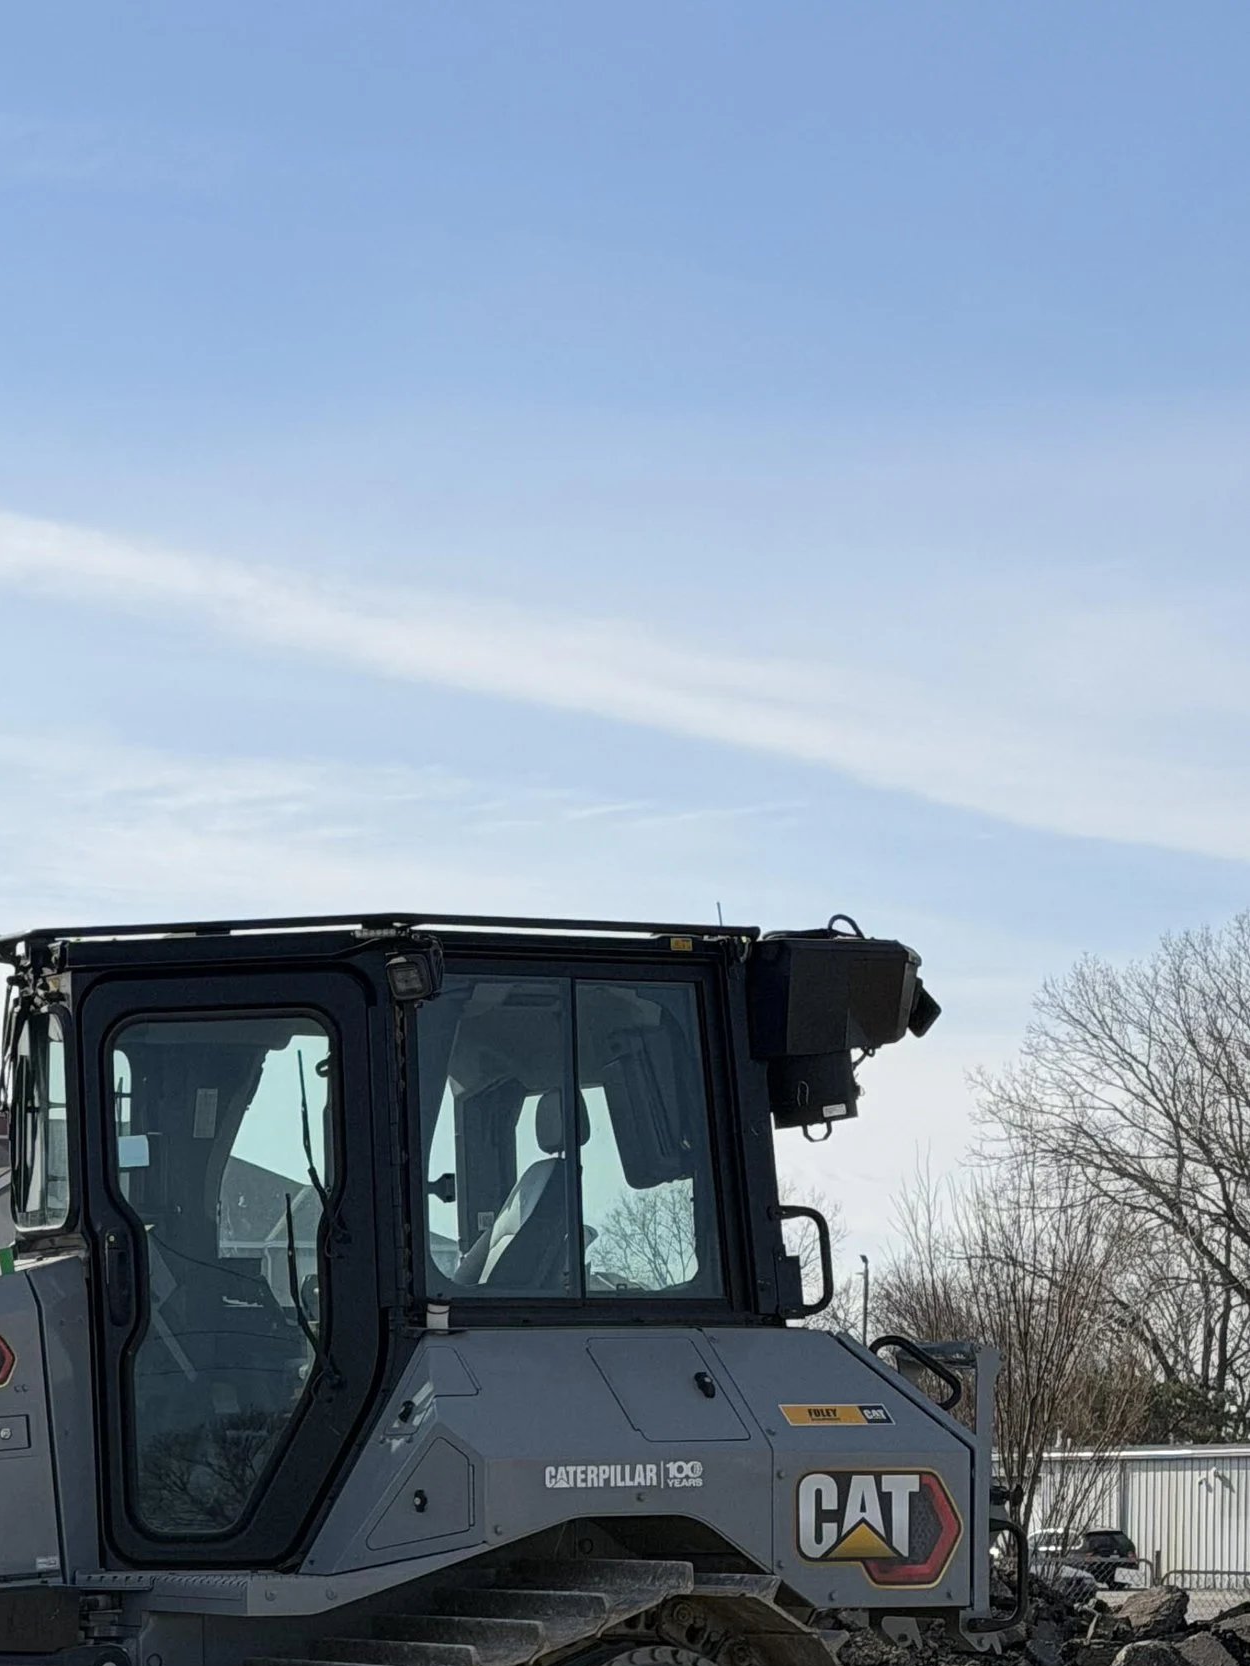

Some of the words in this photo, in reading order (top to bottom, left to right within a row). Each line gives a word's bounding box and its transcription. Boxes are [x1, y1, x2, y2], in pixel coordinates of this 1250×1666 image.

[863, 1409, 886, 1419] CAT
[545, 1464, 657, 1488] CATERPILLAR
[666, 1461, 703, 1478] 100
[666, 1478, 703, 1487] YEARS
[799, 1473, 920, 1558] CAT
